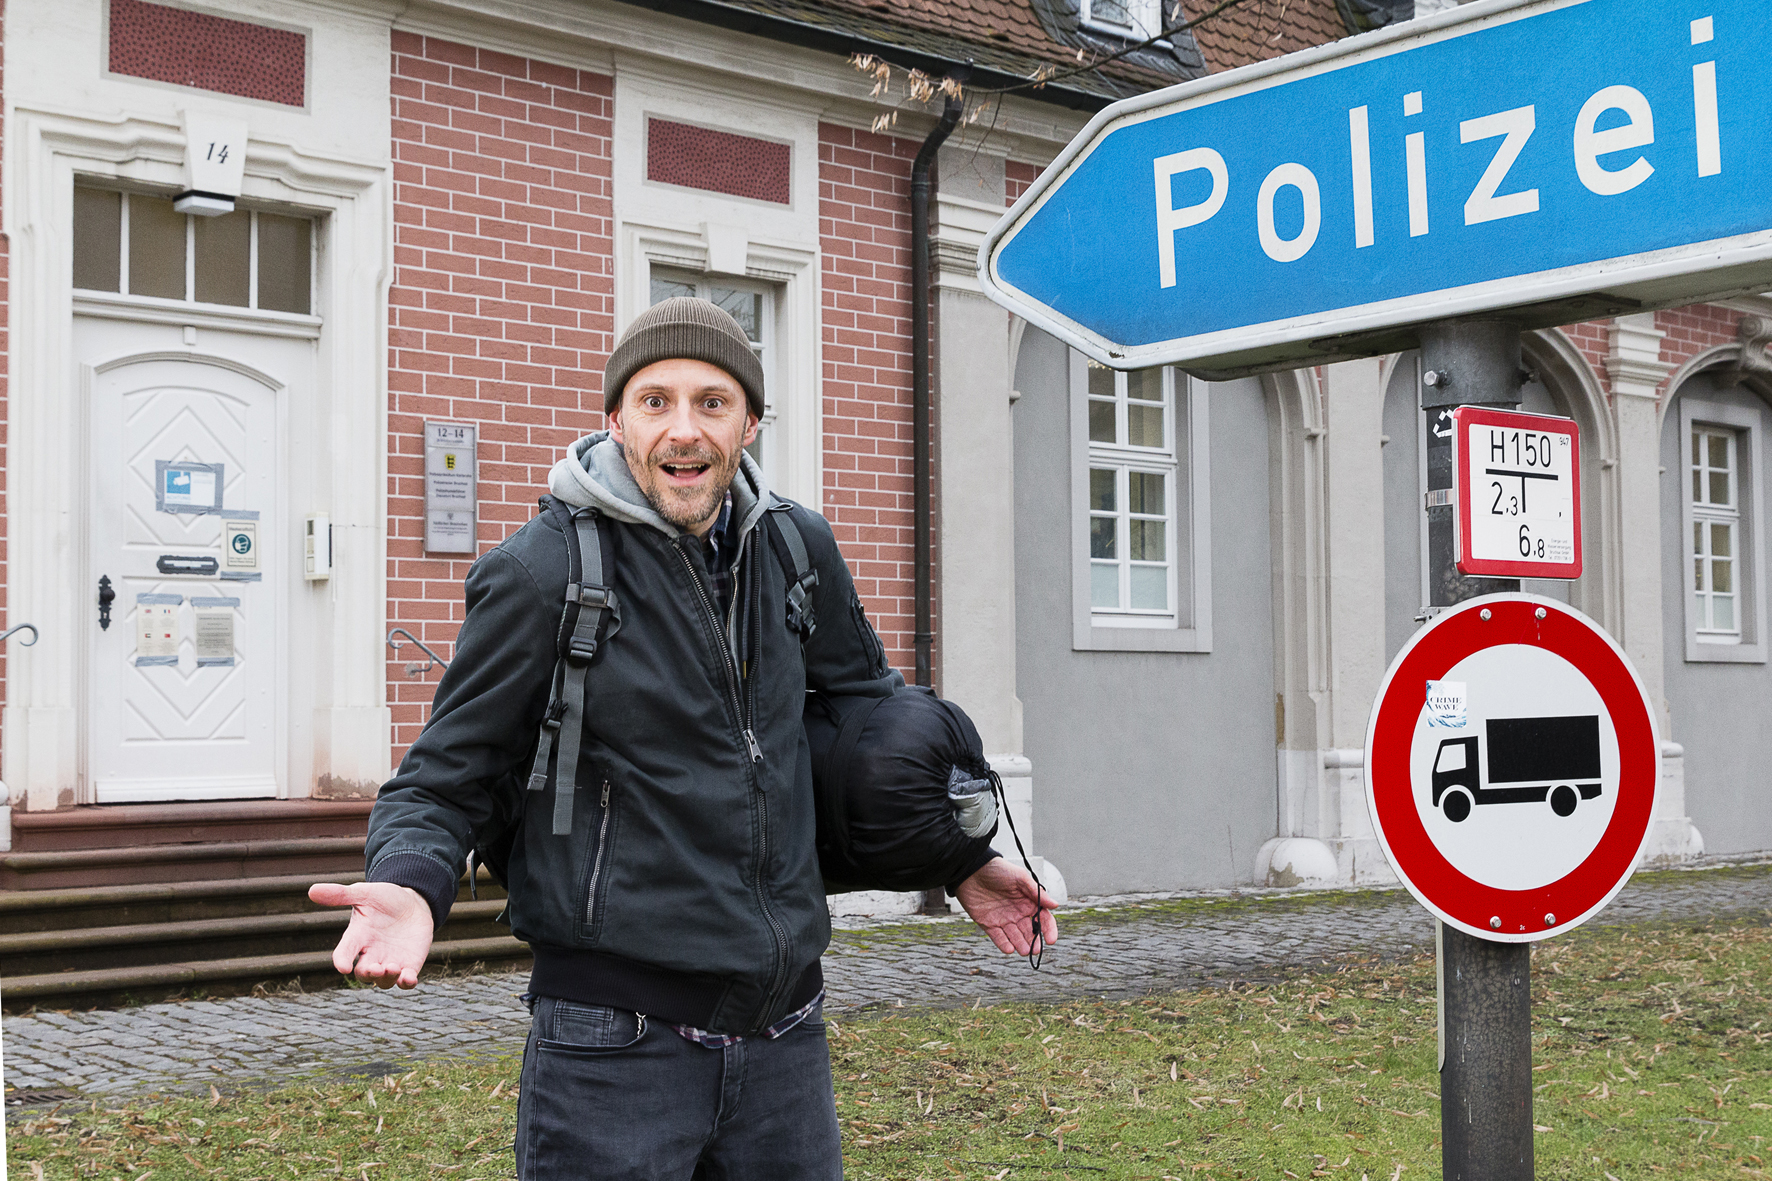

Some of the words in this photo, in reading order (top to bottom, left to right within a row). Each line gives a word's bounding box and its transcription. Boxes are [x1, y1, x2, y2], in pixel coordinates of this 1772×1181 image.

[207, 142, 229, 164] 14
[1153, 15, 1722, 289] Polizei
[1491, 481, 1518, 516] 2,3
[1519, 524, 1545, 559] 6,8
